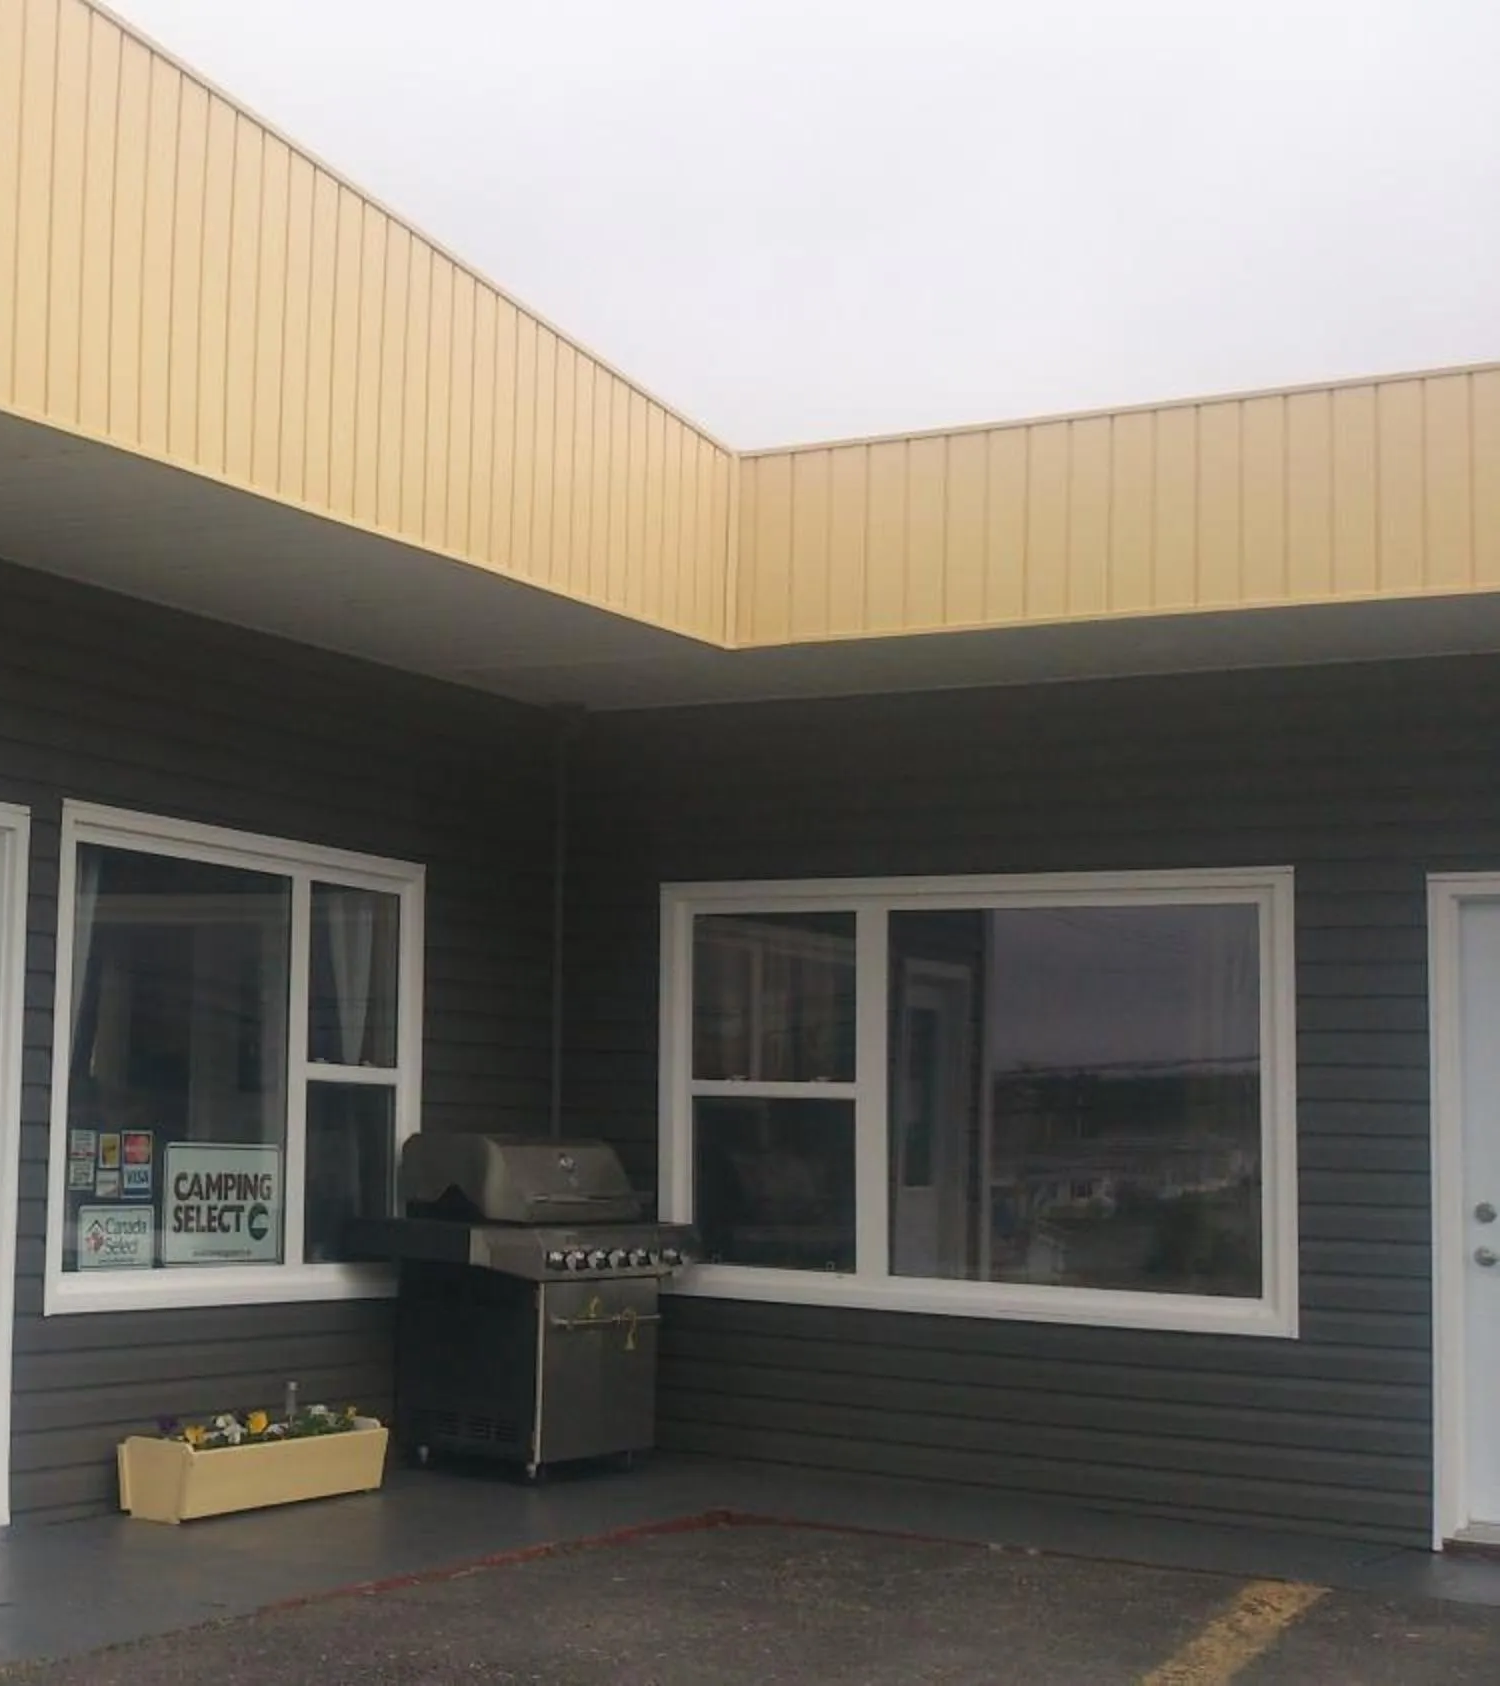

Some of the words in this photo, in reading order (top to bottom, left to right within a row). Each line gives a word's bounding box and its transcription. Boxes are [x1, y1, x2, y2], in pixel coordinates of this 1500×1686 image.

[126, 1169, 149, 1185] VISA
[174, 1172, 273, 1201] CAMPING
[105, 1216, 147, 1234] Canada
[173, 1204, 245, 1233] SELECT
